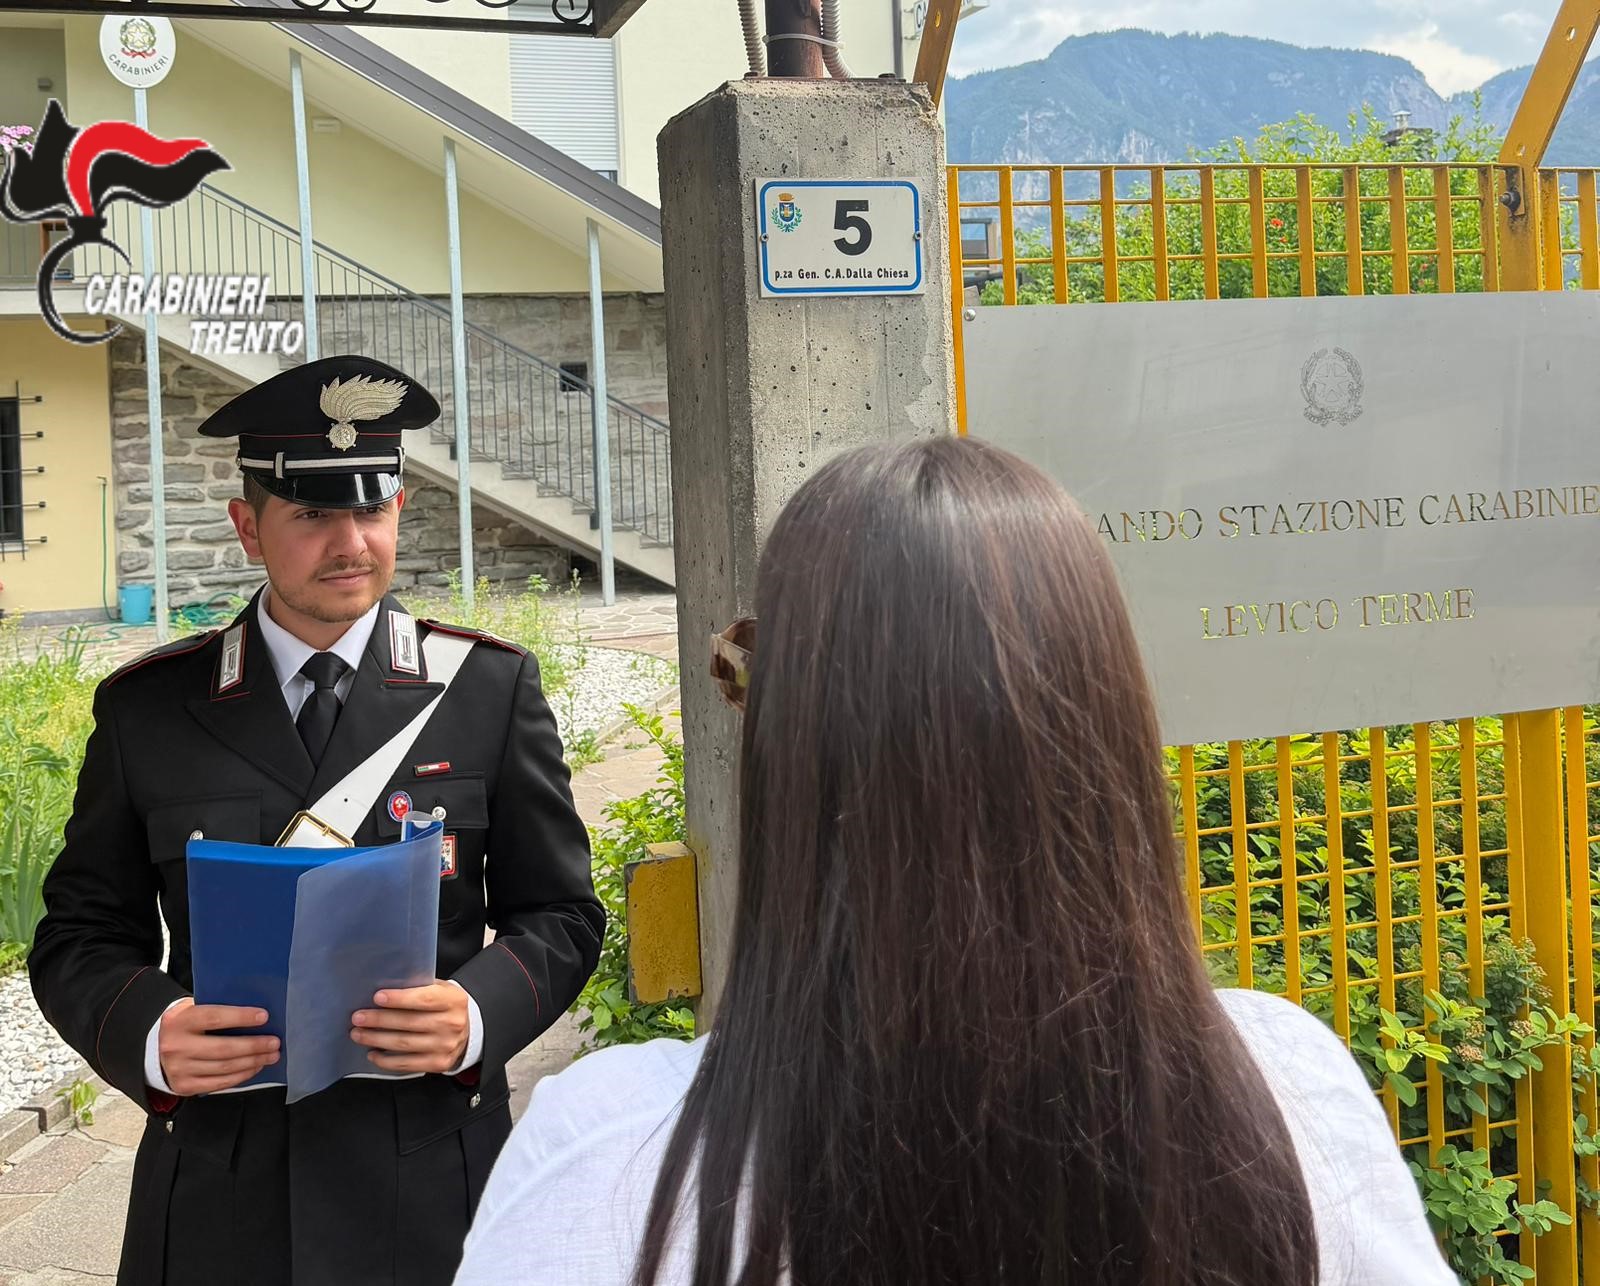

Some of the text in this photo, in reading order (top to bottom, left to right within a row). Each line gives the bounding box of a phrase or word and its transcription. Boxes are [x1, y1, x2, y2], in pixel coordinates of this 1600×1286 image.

[109, 54, 169, 76] CARABINIERI
[833, 199, 873, 256] 5
[774, 269, 793, 281] p.za
[797, 268, 820, 280] Gen.
[876, 267, 909, 280] Chiesa
[1084, 485, 1600, 543] ANDO STAZIONE CARABINIE
[1200, 588, 1477, 640] LEVICO TERME
